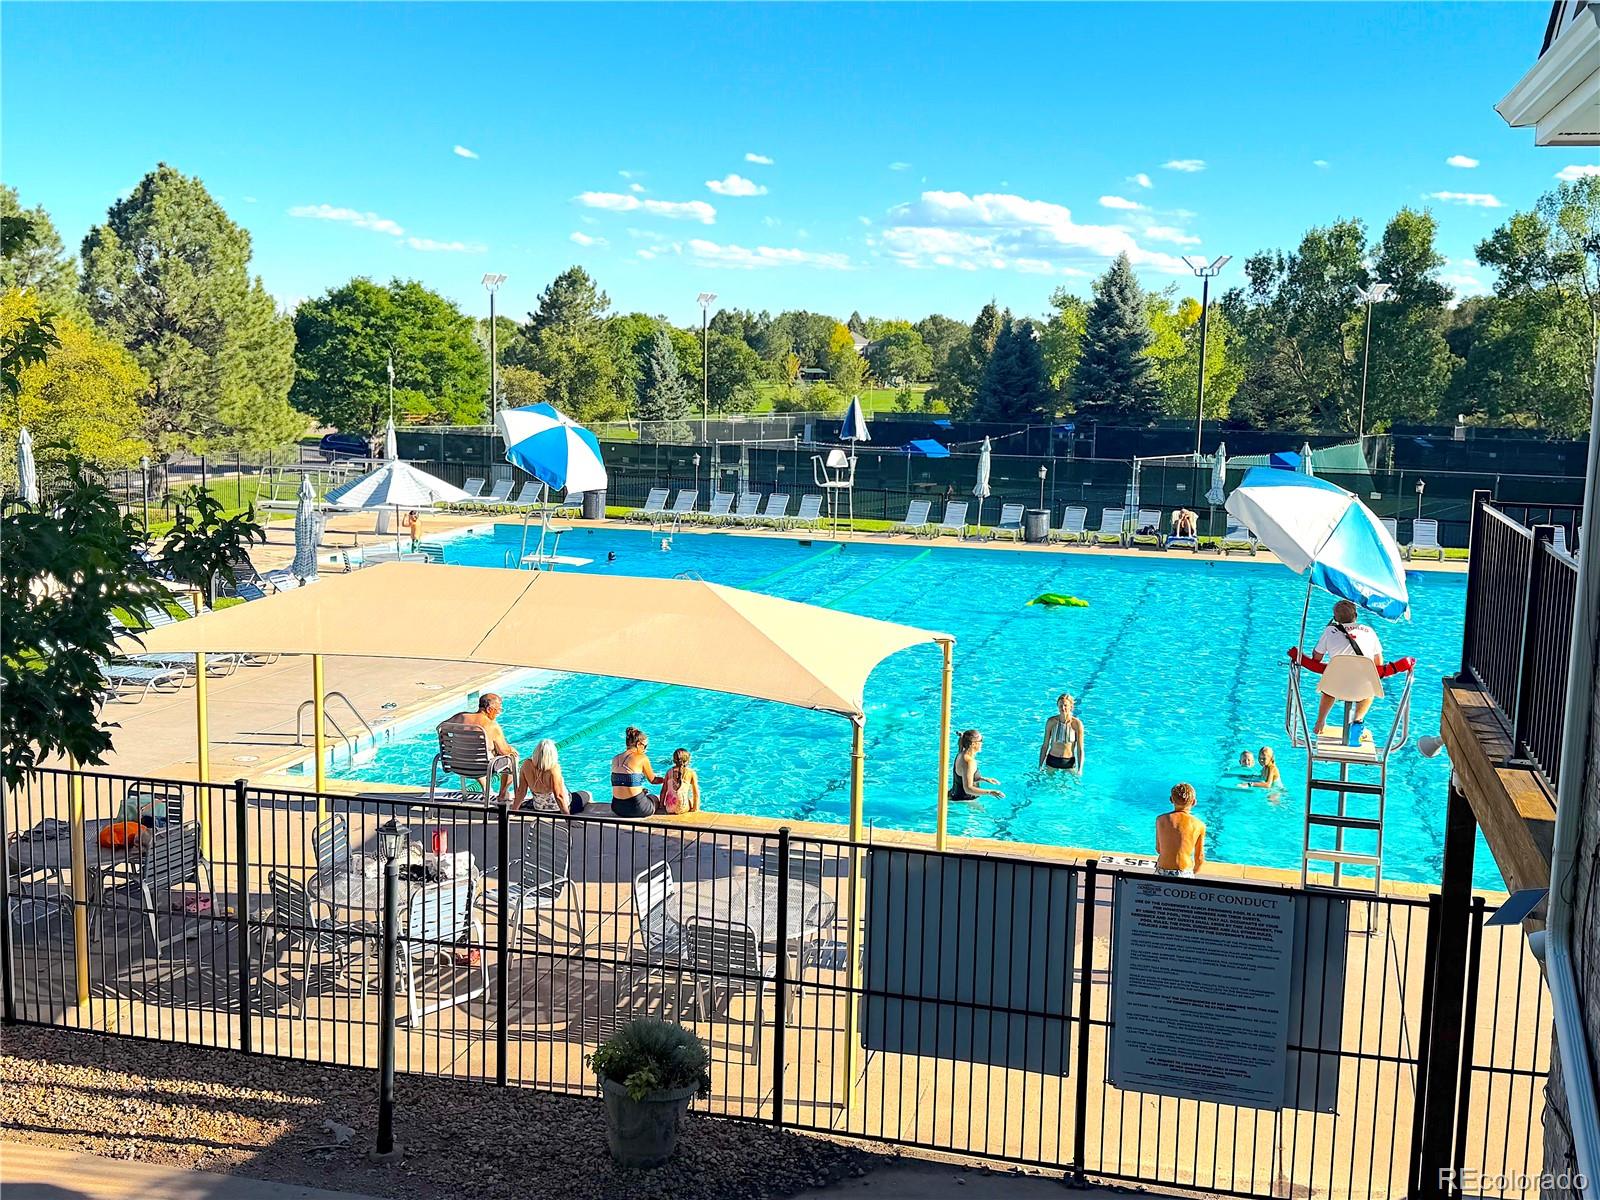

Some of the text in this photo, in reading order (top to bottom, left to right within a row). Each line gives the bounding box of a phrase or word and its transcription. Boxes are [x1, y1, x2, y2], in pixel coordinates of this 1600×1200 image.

[1164, 888, 1278, 908] CODE OF CONDUCT
